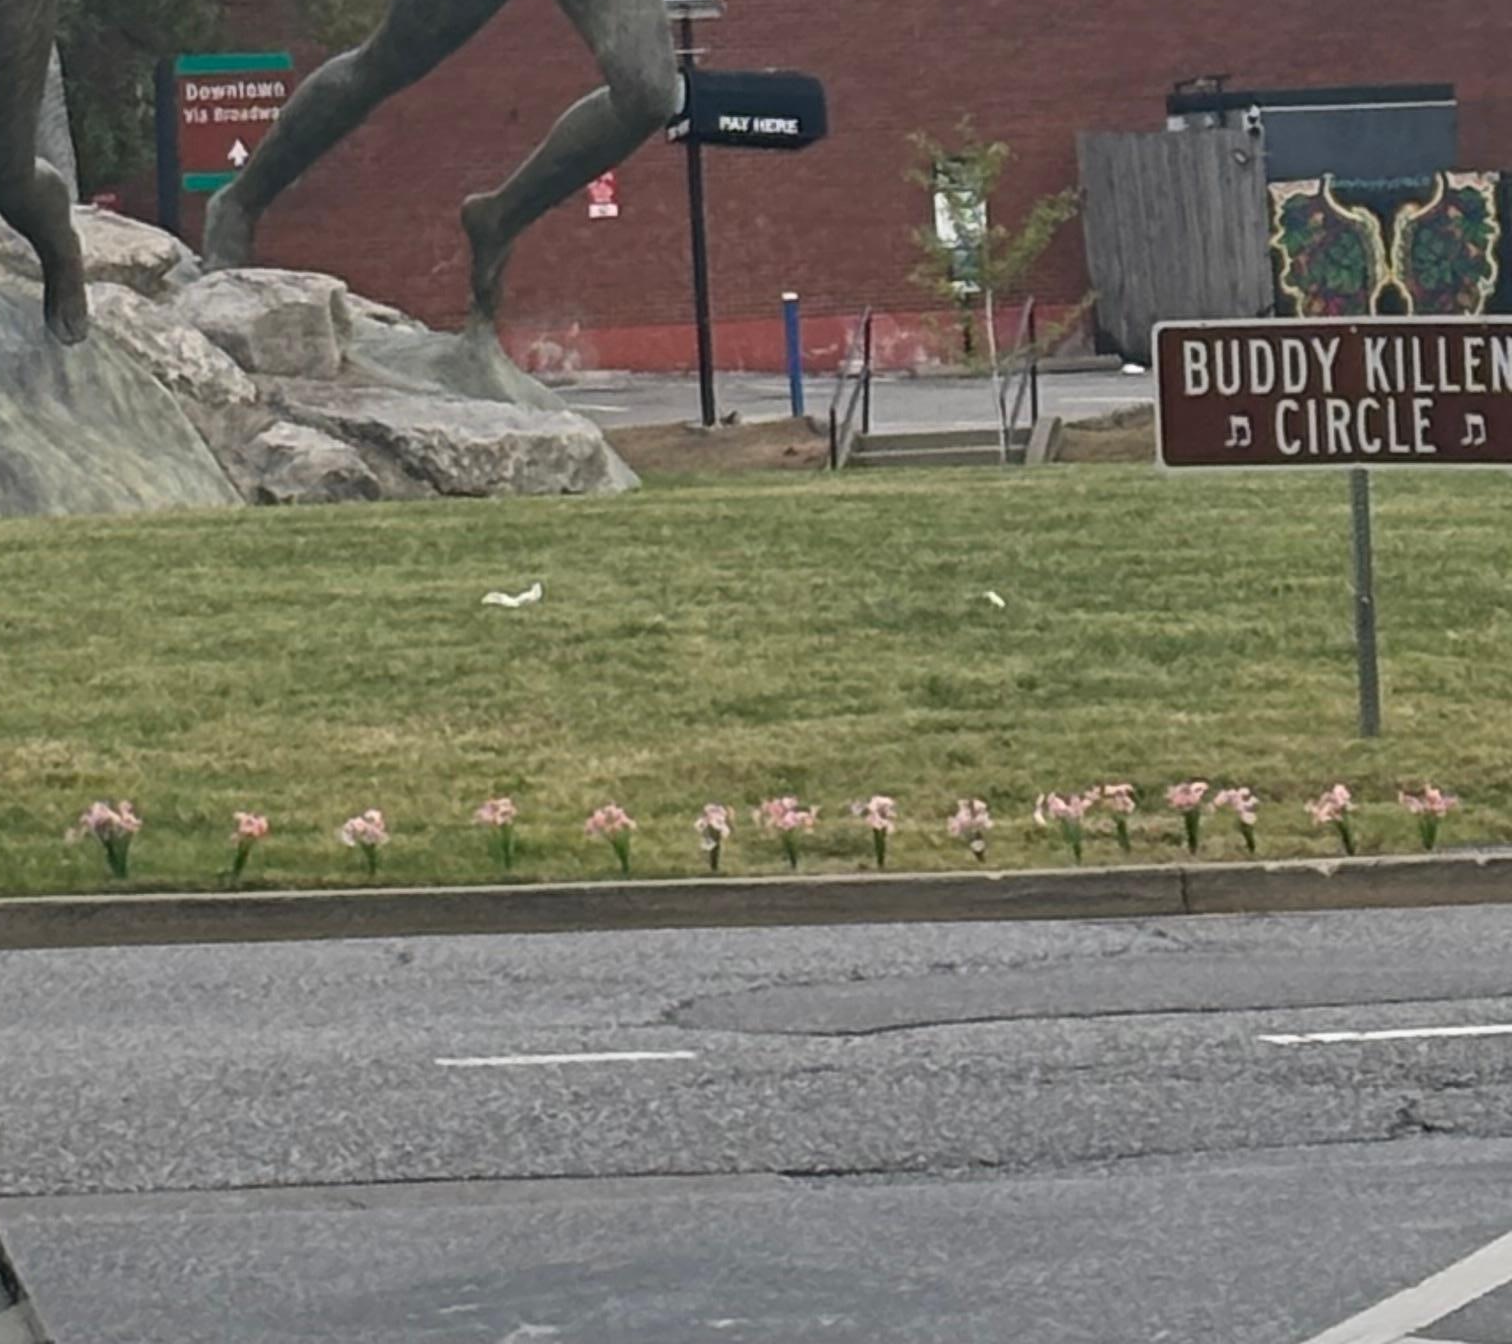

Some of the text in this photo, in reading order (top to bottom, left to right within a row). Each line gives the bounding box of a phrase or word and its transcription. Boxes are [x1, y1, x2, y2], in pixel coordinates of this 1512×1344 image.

[213, 105, 281, 122] Broadwa
[719, 115, 799, 135] PAY HERE
[1183, 335, 1512, 396] BUDDY KILLEN
[1275, 397, 1437, 455] CIRCLE
